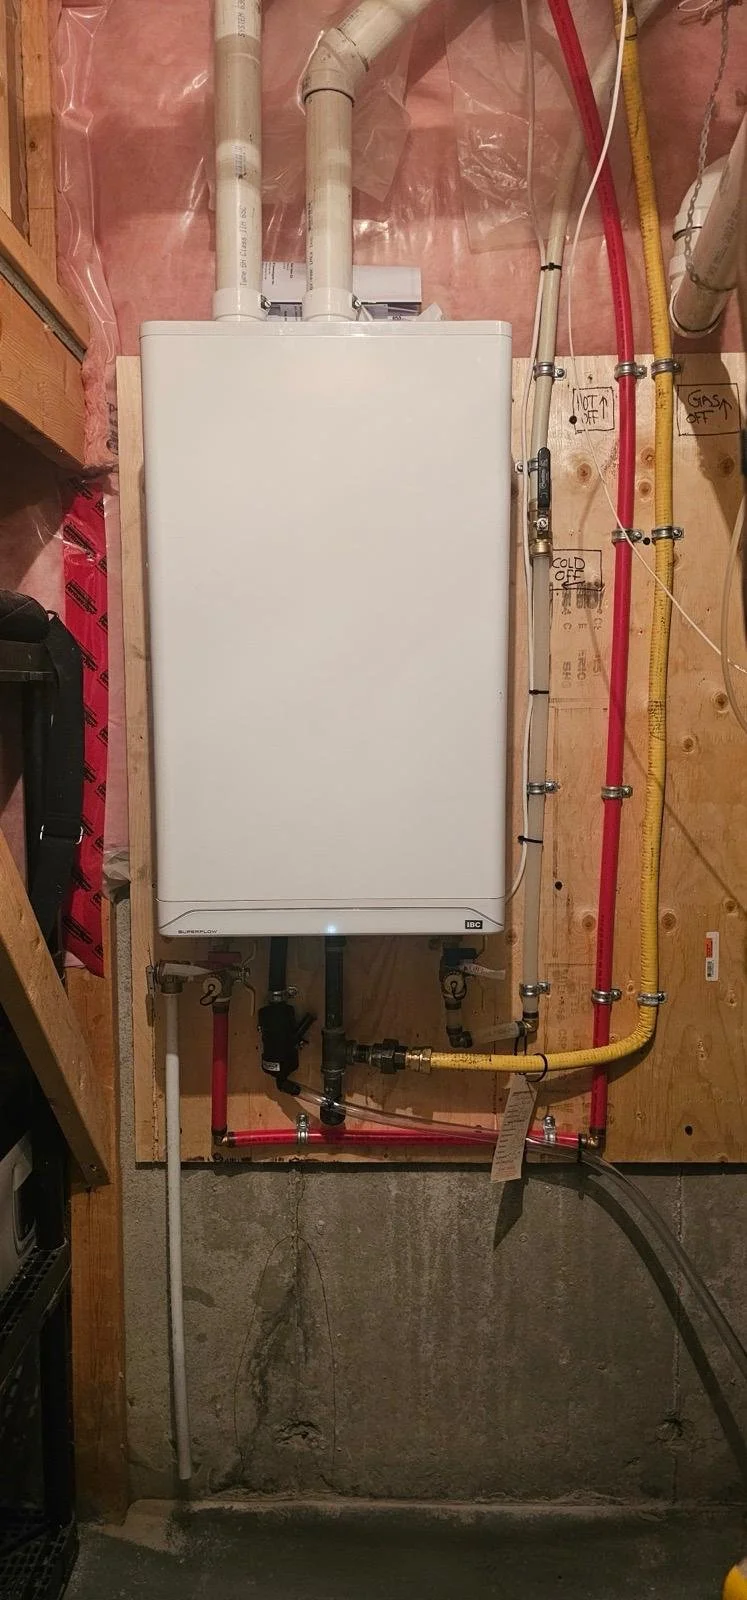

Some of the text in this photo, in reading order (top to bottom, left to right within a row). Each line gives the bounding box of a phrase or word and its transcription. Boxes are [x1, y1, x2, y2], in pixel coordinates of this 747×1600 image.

[688, 389, 720, 408] GAS
[686, 410, 714, 424] OFF
[551, 556, 586, 570] COLD
[555, 569, 585, 584] OFF
